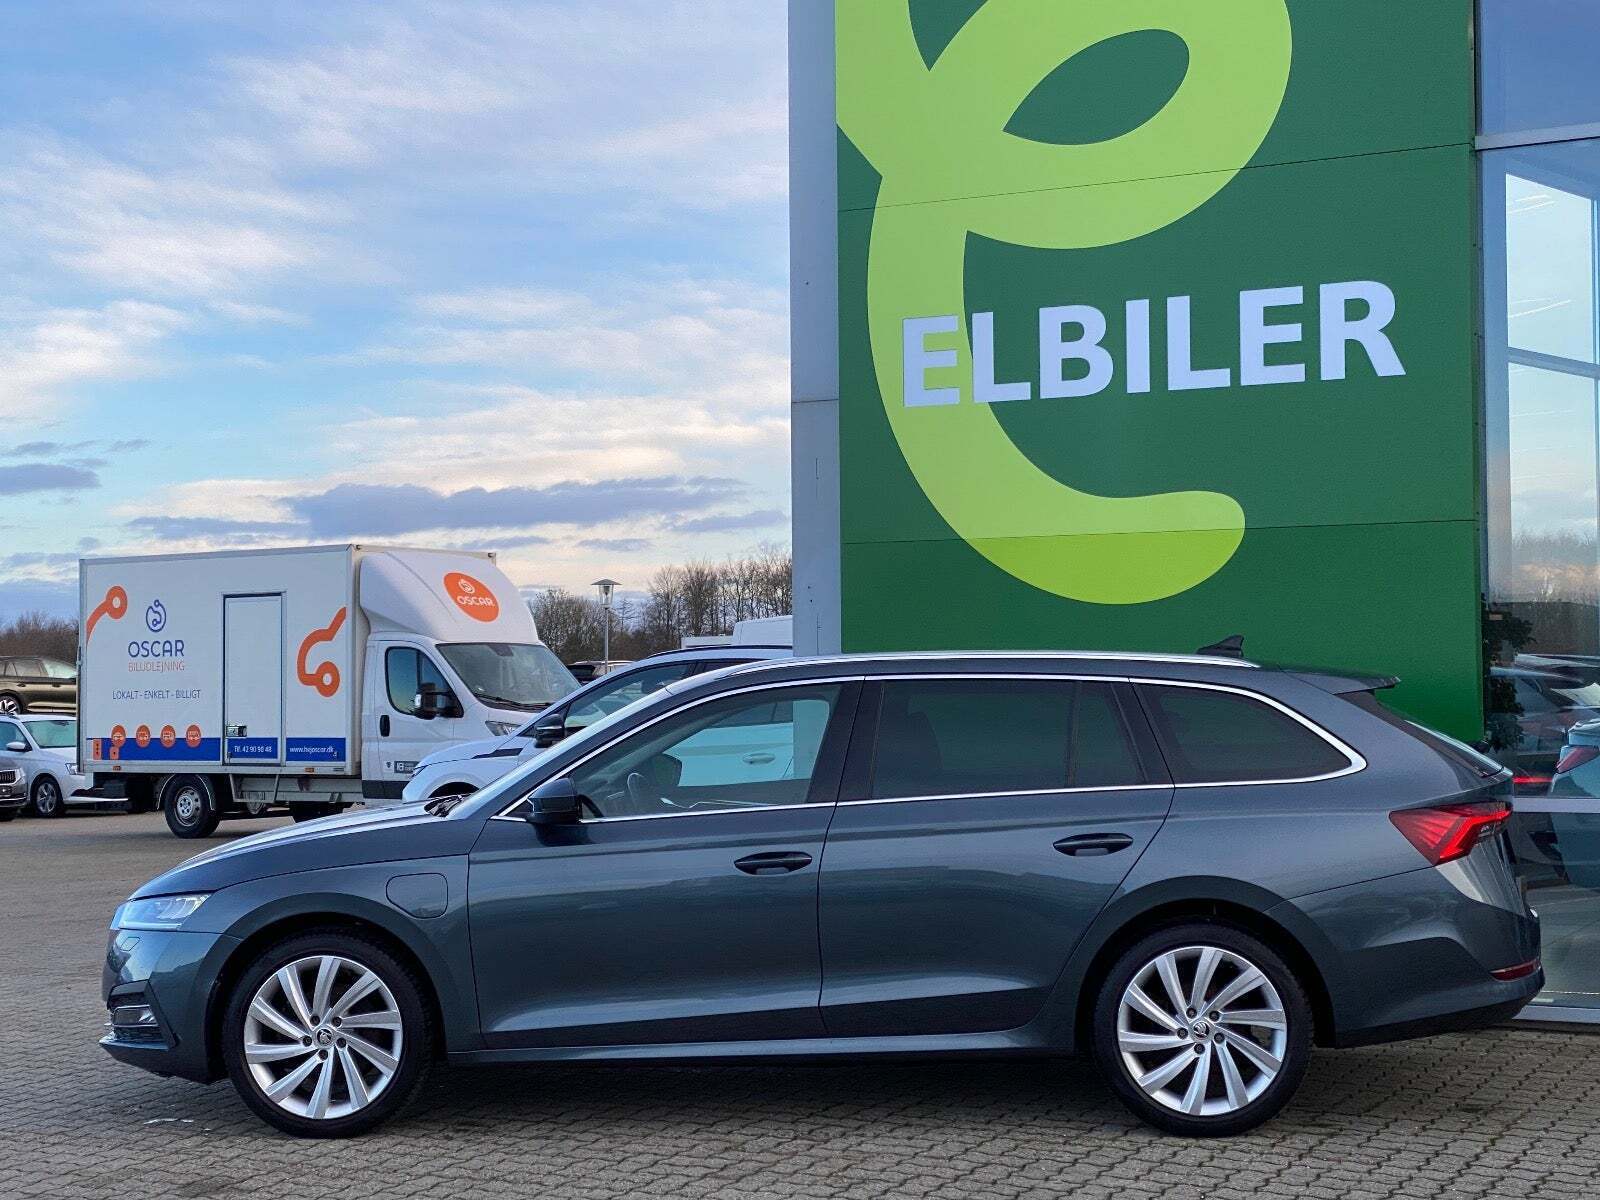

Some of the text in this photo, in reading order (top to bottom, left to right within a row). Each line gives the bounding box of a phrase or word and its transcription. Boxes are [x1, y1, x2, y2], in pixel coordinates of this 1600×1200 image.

[902, 280, 1407, 407] ELBILER
[457, 595, 496, 607] OSCAR
[128, 639, 185, 658] OSCAR
[128, 660, 185, 673] BILUDLEJNING
[112, 690, 139, 700] LOKALT
[144, 689, 170, 699] ENKELT
[175, 689, 201, 699] BILLIGT
